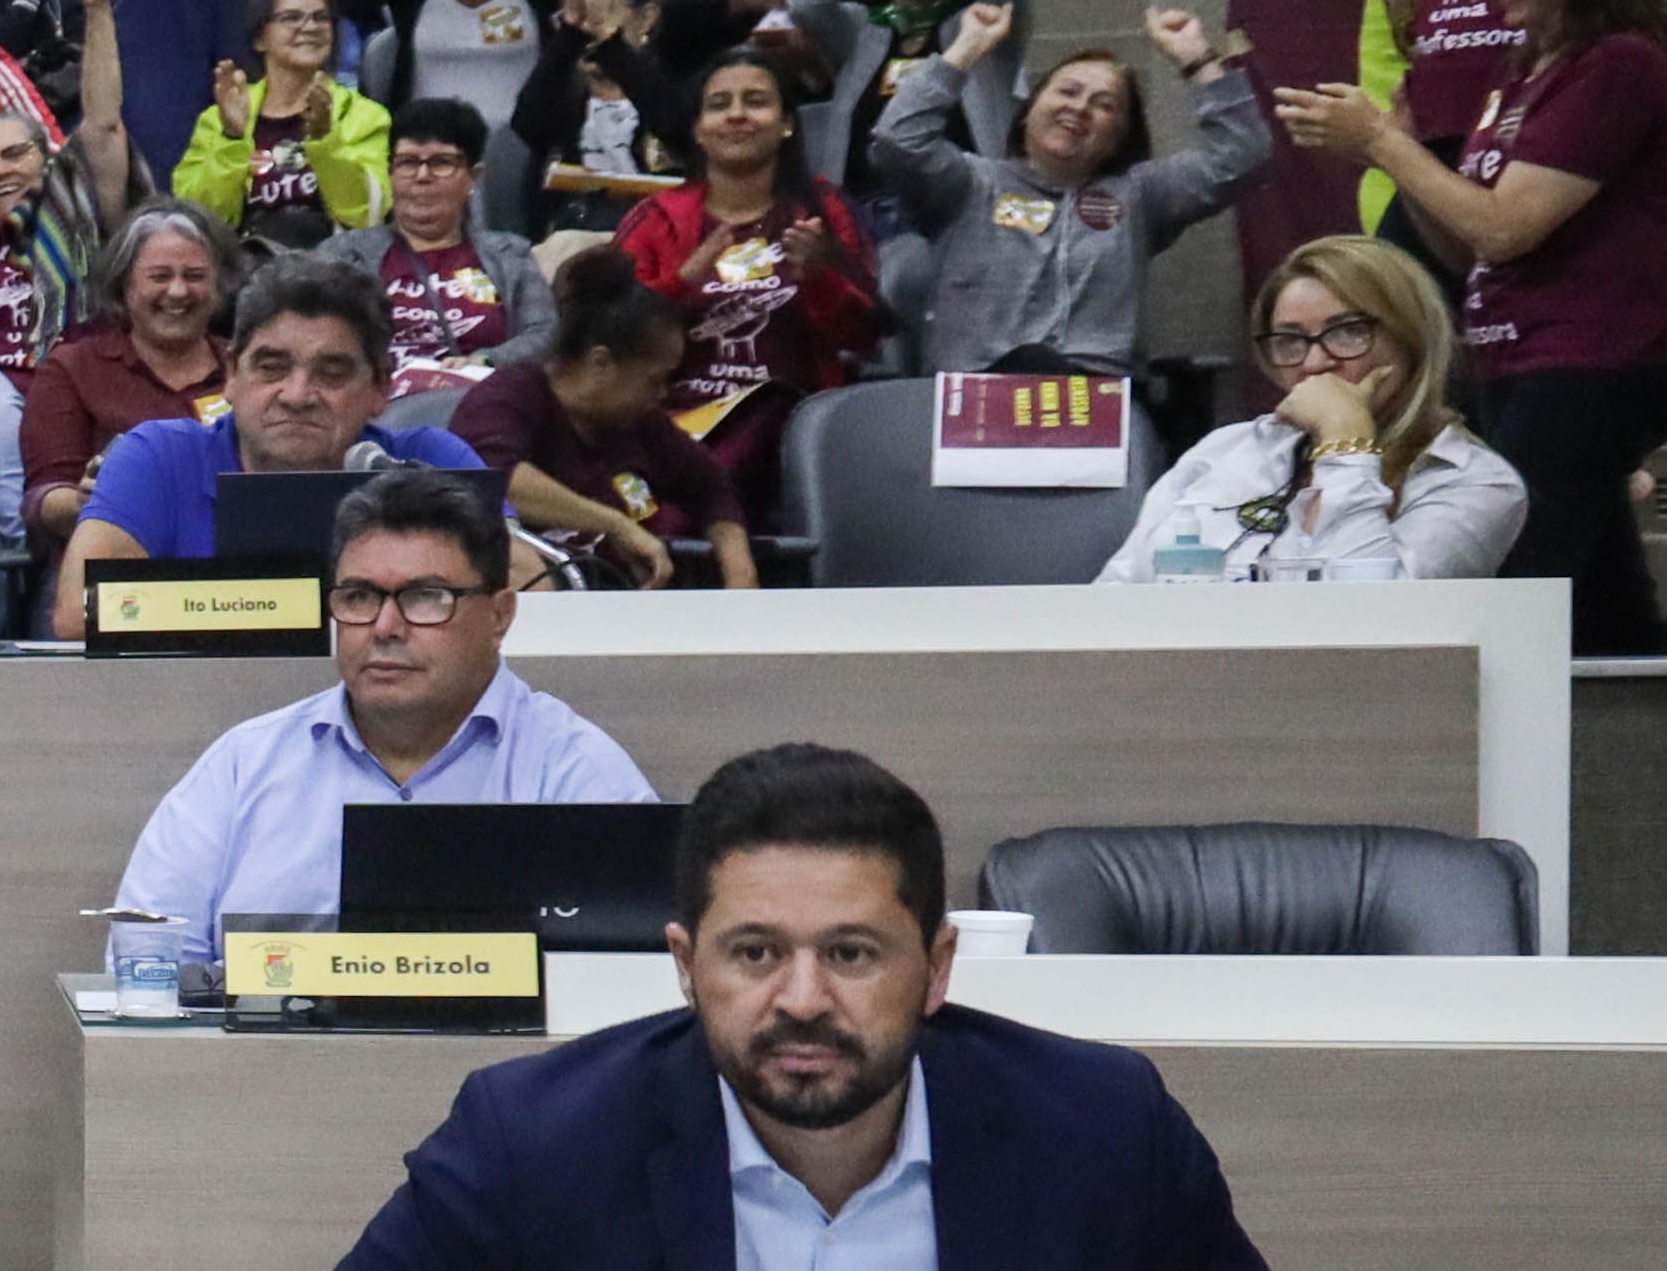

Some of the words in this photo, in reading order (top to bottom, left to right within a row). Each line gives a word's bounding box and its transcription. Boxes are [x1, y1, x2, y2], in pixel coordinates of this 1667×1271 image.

[1428, 2, 1489, 24] uma
[386, 272, 466, 299] Lute
[701, 275, 782, 294] como
[183, 598, 206, 613] Ito
[211, 596, 278, 613] Luciano
[331, 955, 385, 976] Enio
[396, 955, 490, 976] Brizola
